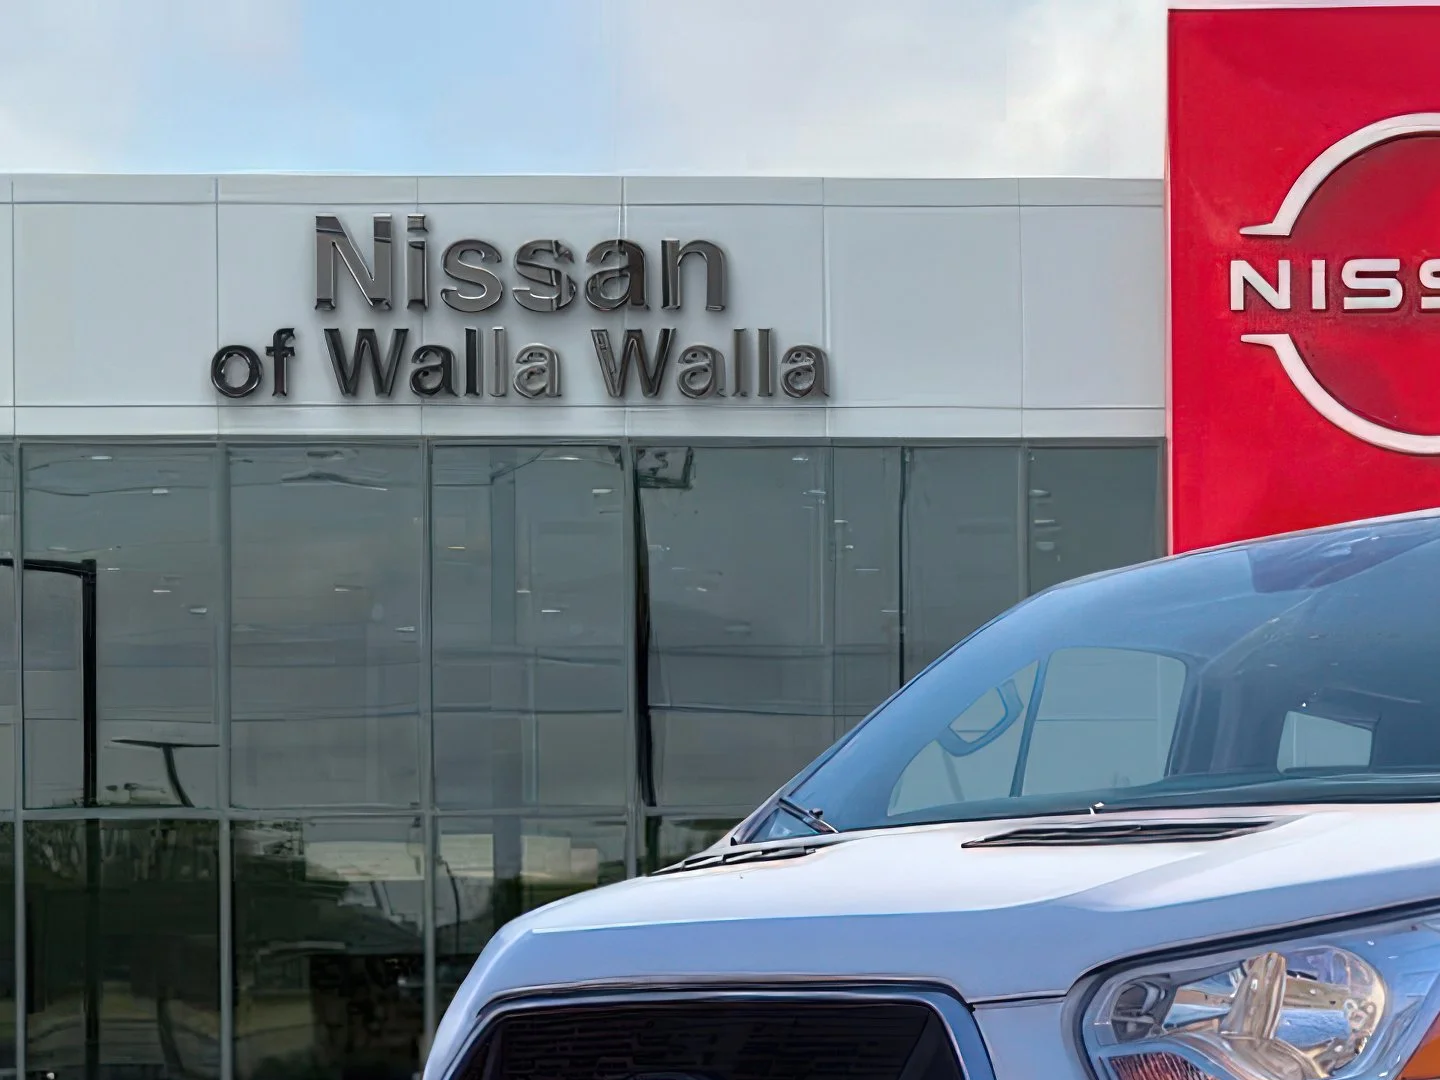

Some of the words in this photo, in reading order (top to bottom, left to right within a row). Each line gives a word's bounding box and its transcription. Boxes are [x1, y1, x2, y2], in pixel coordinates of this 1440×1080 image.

[313, 212, 730, 313] Nissan
[210, 327, 296, 399] of
[324, 327, 563, 399] Walla
[590, 327, 831, 399] Walla
